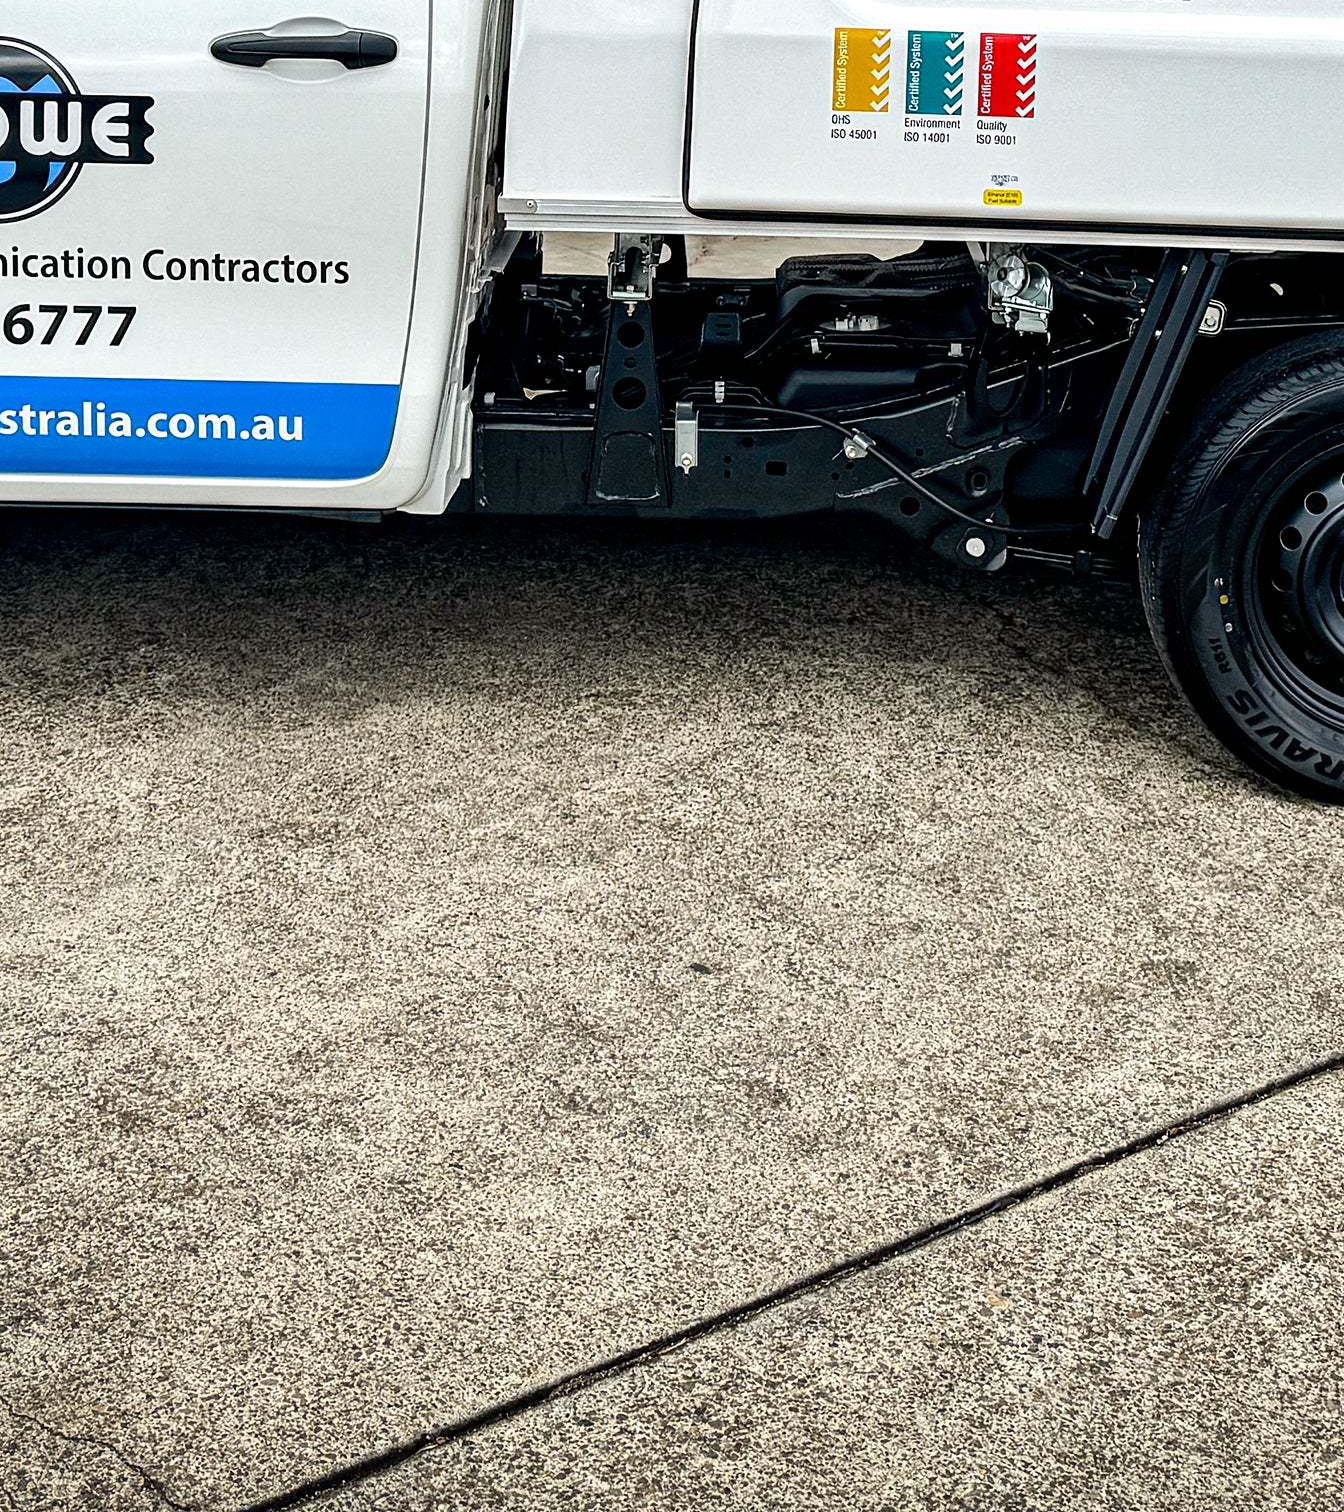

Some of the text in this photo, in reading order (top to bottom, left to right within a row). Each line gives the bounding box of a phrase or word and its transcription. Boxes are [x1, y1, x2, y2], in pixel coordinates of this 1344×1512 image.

[835, 31, 849, 108] Certified System
[908, 33, 923, 111] Certified System
[980, 36, 994, 114] Certified System
[831, 114, 851, 124] OHS
[904, 117, 961, 129] Environment
[976, 120, 1008, 132] Quality
[831, 128, 877, 140] ISO 45001
[904, 131, 950, 143] ISO 14001
[976, 134, 1016, 145] ISO 9001
[142, 250, 351, 285] Contractors
[3, 304, 138, 347] 6777
